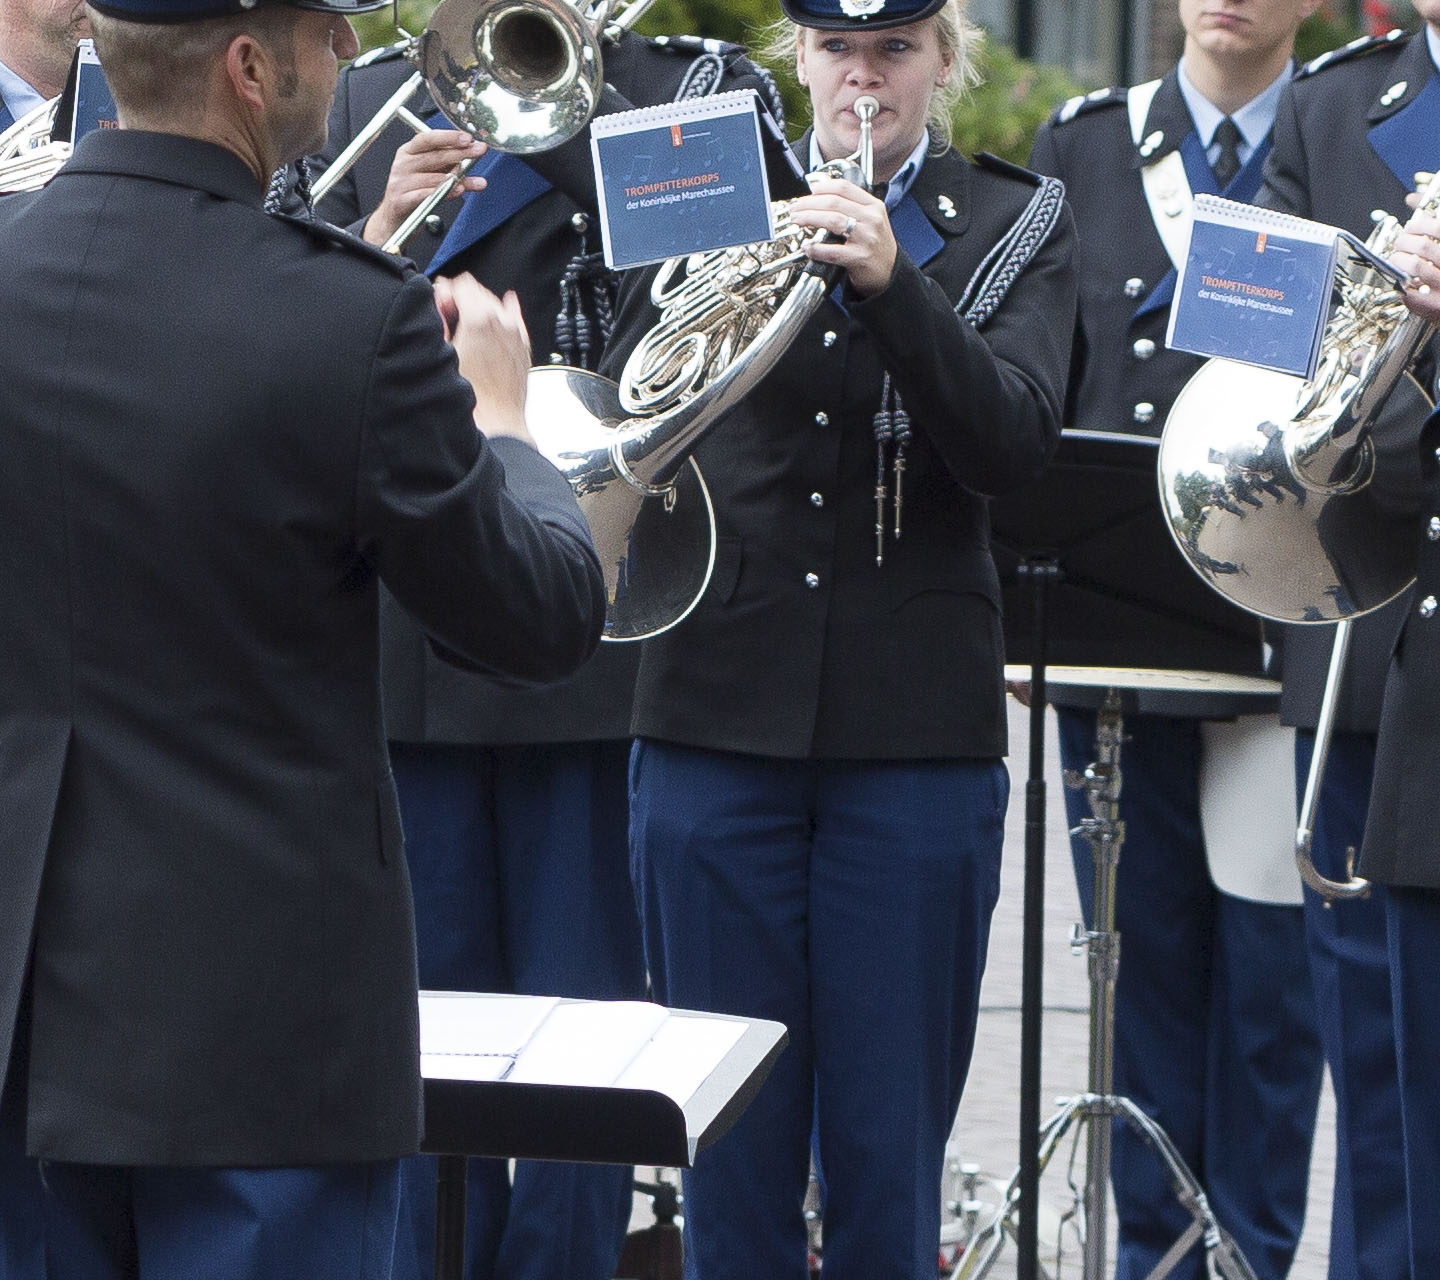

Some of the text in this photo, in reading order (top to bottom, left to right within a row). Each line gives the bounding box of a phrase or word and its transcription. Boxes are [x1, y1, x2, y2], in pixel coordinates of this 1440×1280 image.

[624, 172, 720, 197] TROMPETTERKORPS
[626, 184, 735, 210] der Koninklijke Marechaussee
[1201, 275, 1285, 301] TROMPETTERKORPS
[1197, 288, 1294, 316] der Koninklijke Marechaussee
